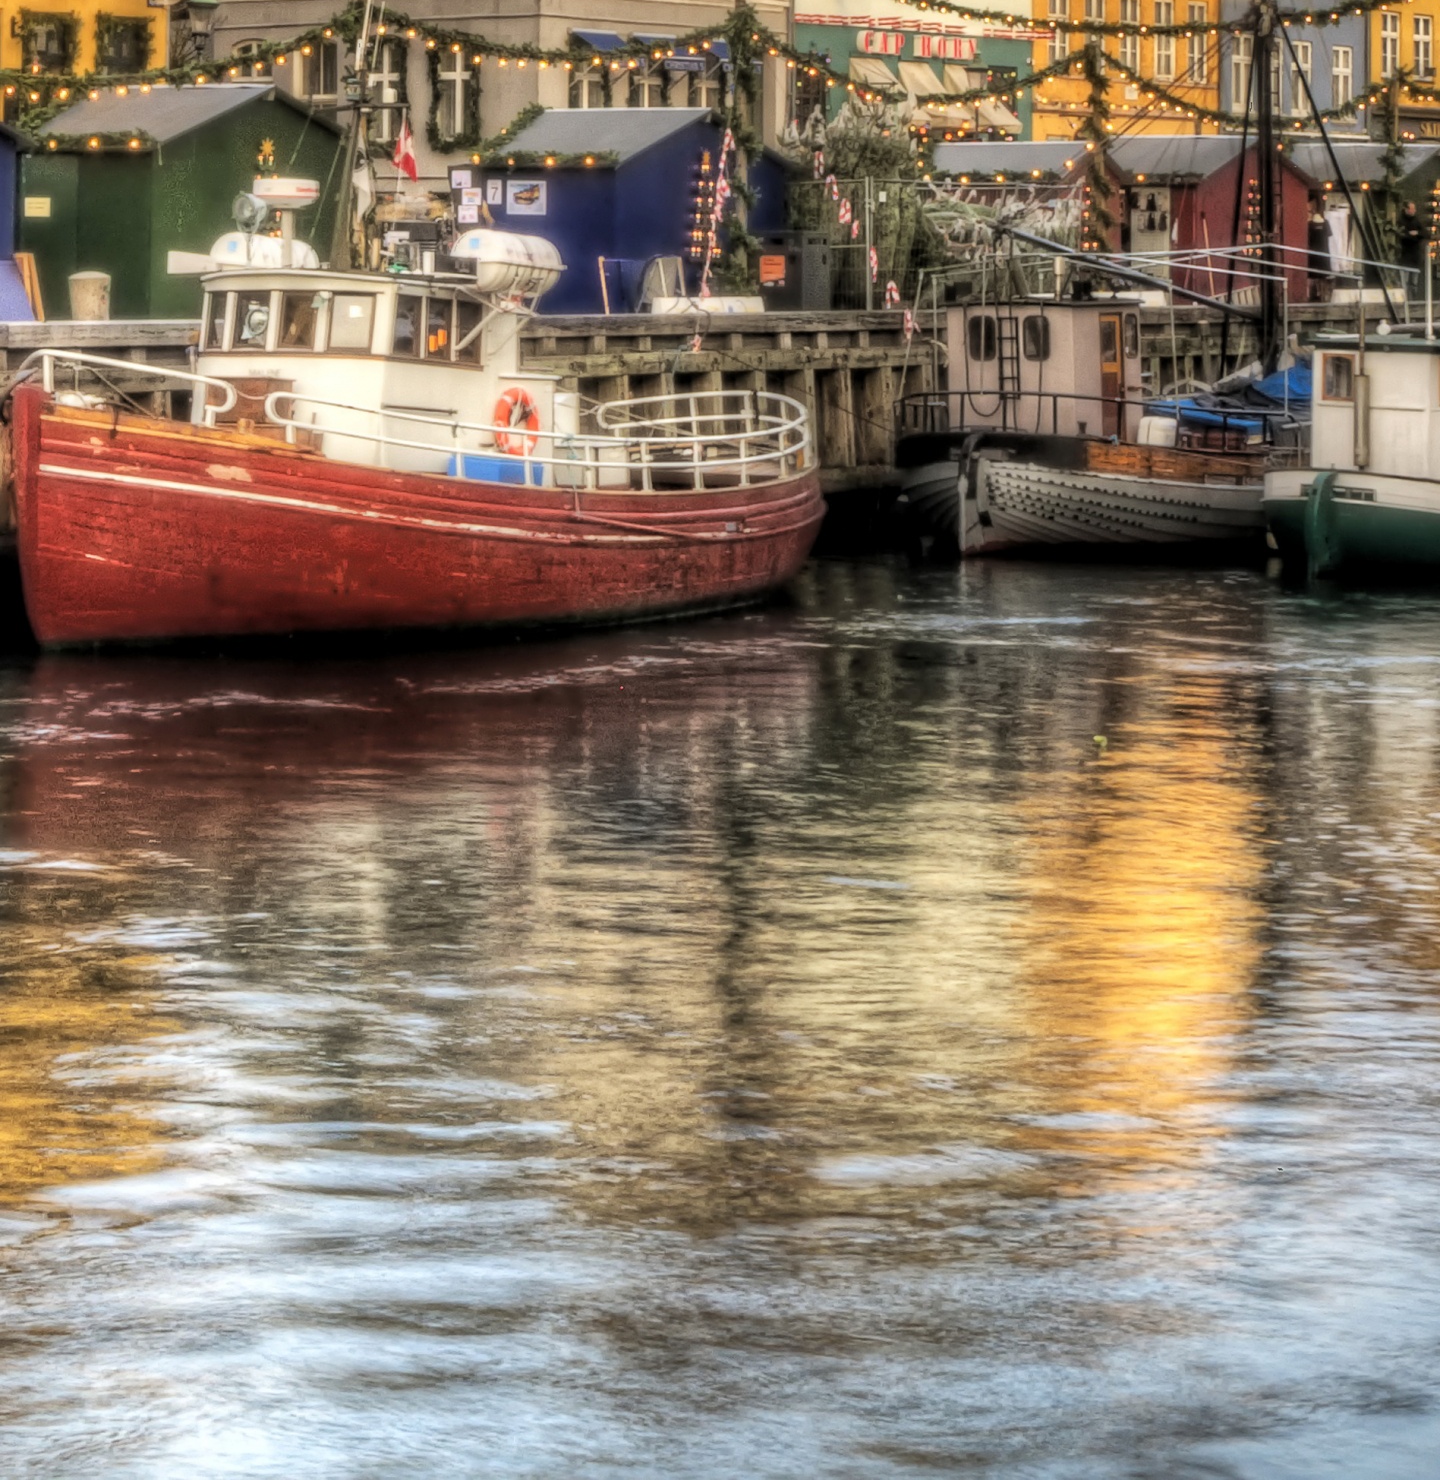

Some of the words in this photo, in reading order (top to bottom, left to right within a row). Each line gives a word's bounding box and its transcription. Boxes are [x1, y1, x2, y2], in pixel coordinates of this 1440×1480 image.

[858, 30, 905, 56] CAP
[914, 34, 977, 60] HORN
[490, 186, 499, 202] 7
